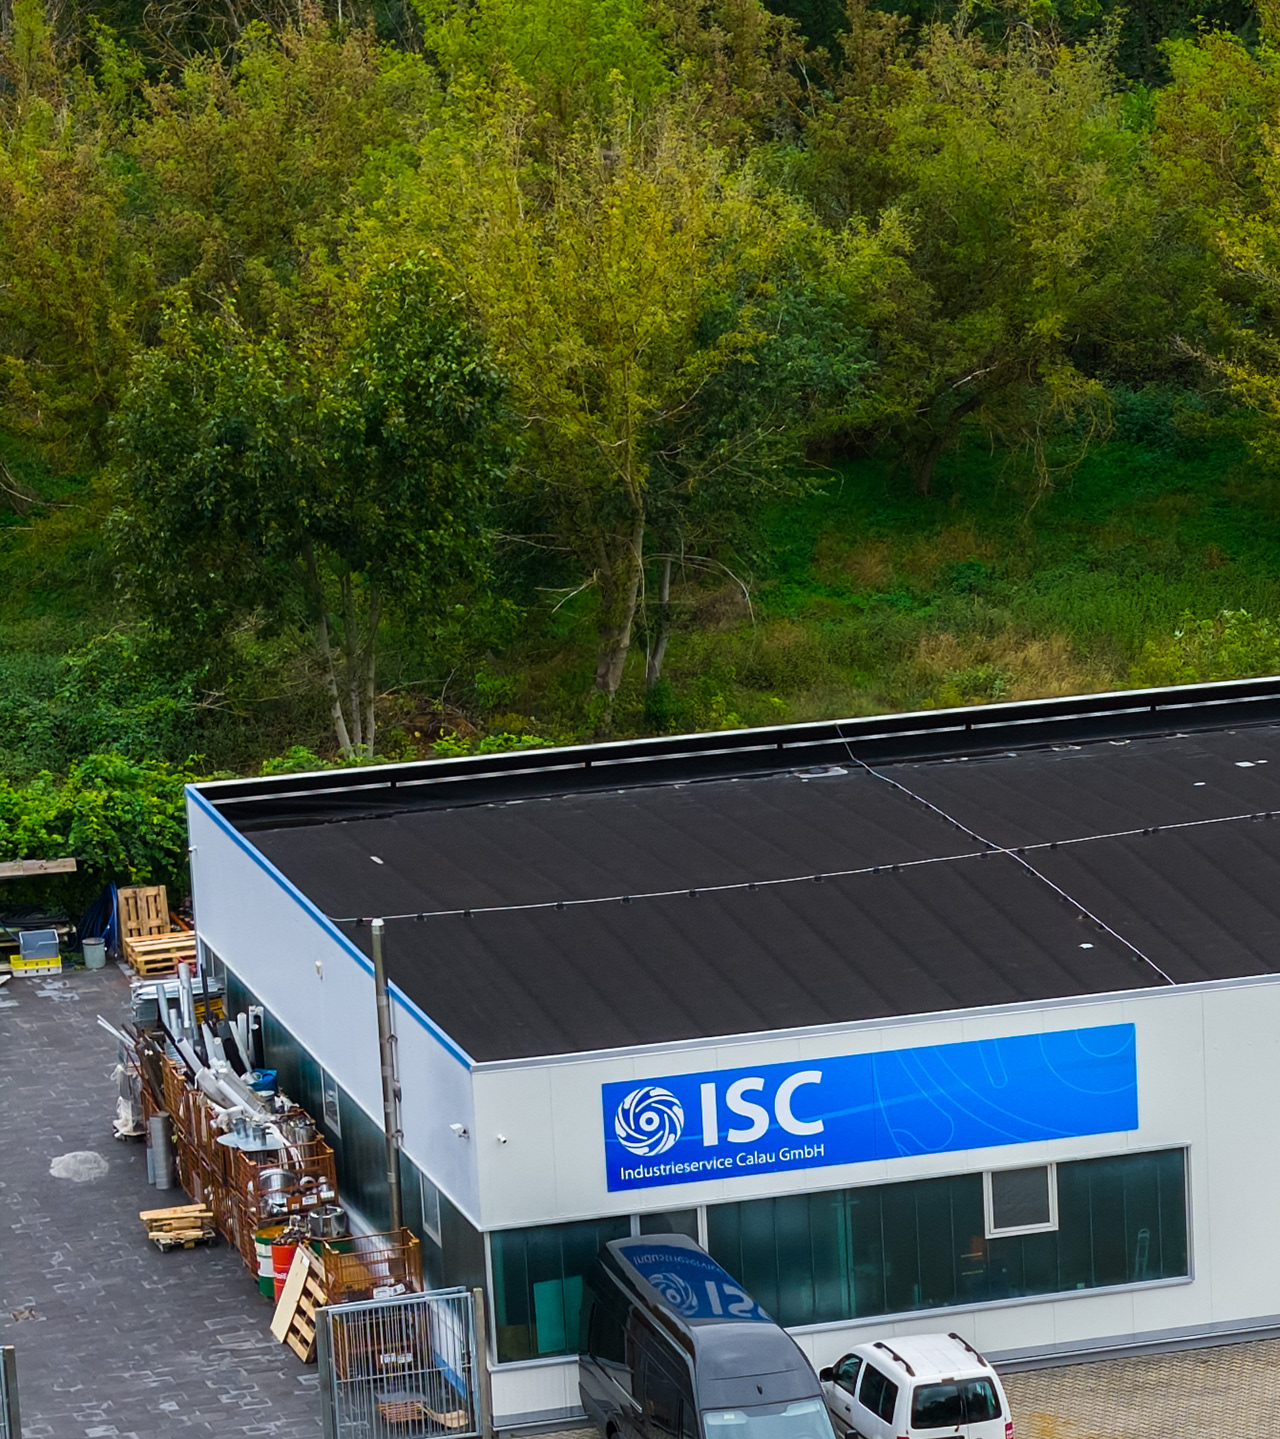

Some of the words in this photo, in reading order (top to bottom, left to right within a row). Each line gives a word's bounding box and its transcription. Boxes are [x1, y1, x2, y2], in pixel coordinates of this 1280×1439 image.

[700, 1070, 825, 1147] ISC
[620, 1156, 733, 1180] Industrieservice
[736, 1151, 776, 1166] Calau
[779, 1144, 825, 1161] GmbH
